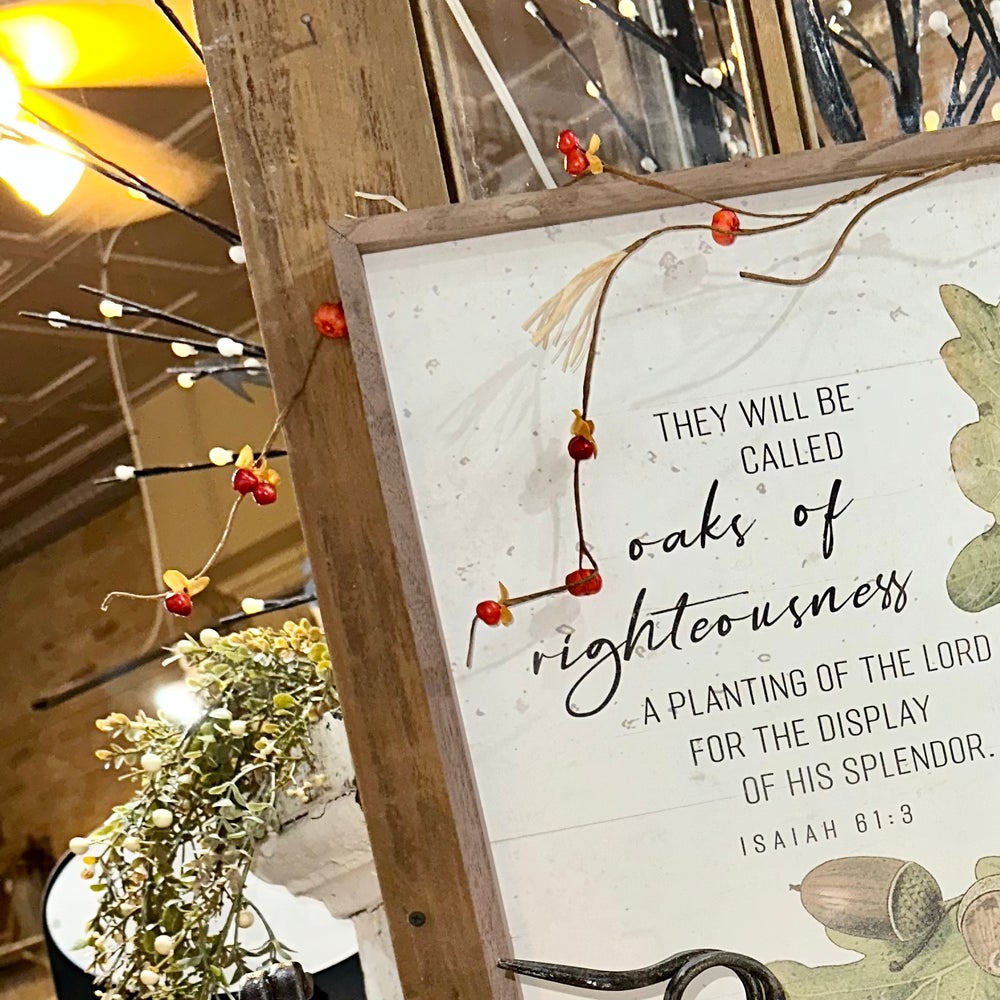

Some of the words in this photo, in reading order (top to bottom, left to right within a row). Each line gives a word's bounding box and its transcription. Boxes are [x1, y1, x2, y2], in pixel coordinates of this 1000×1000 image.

[654, 404, 728, 442] THEY
[739, 392, 809, 429] WILL
[816, 383, 854, 416] BE
[740, 431, 844, 475] CALLED
[629, 479, 756, 561] oaks
[794, 479, 854, 559] of
[532, 570, 913, 718] righteousness
[643, 697, 660, 725] A
[669, 669, 807, 720] PLANTING
[816, 660, 849, 693] OF
[859, 649, 915, 684] THE
[923, 633, 992, 672] LORD
[689, 731, 746, 766] FOR
[752, 718, 810, 753] THE
[819, 695, 931, 742] DISPLAY
[743, 773, 775, 804] OF
[786, 762, 834, 797] HIS
[843, 733, 995, 785] SPLENDOR.
[740, 822, 838, 856] ISAIAH
[856, 804, 914, 834] 61:3
